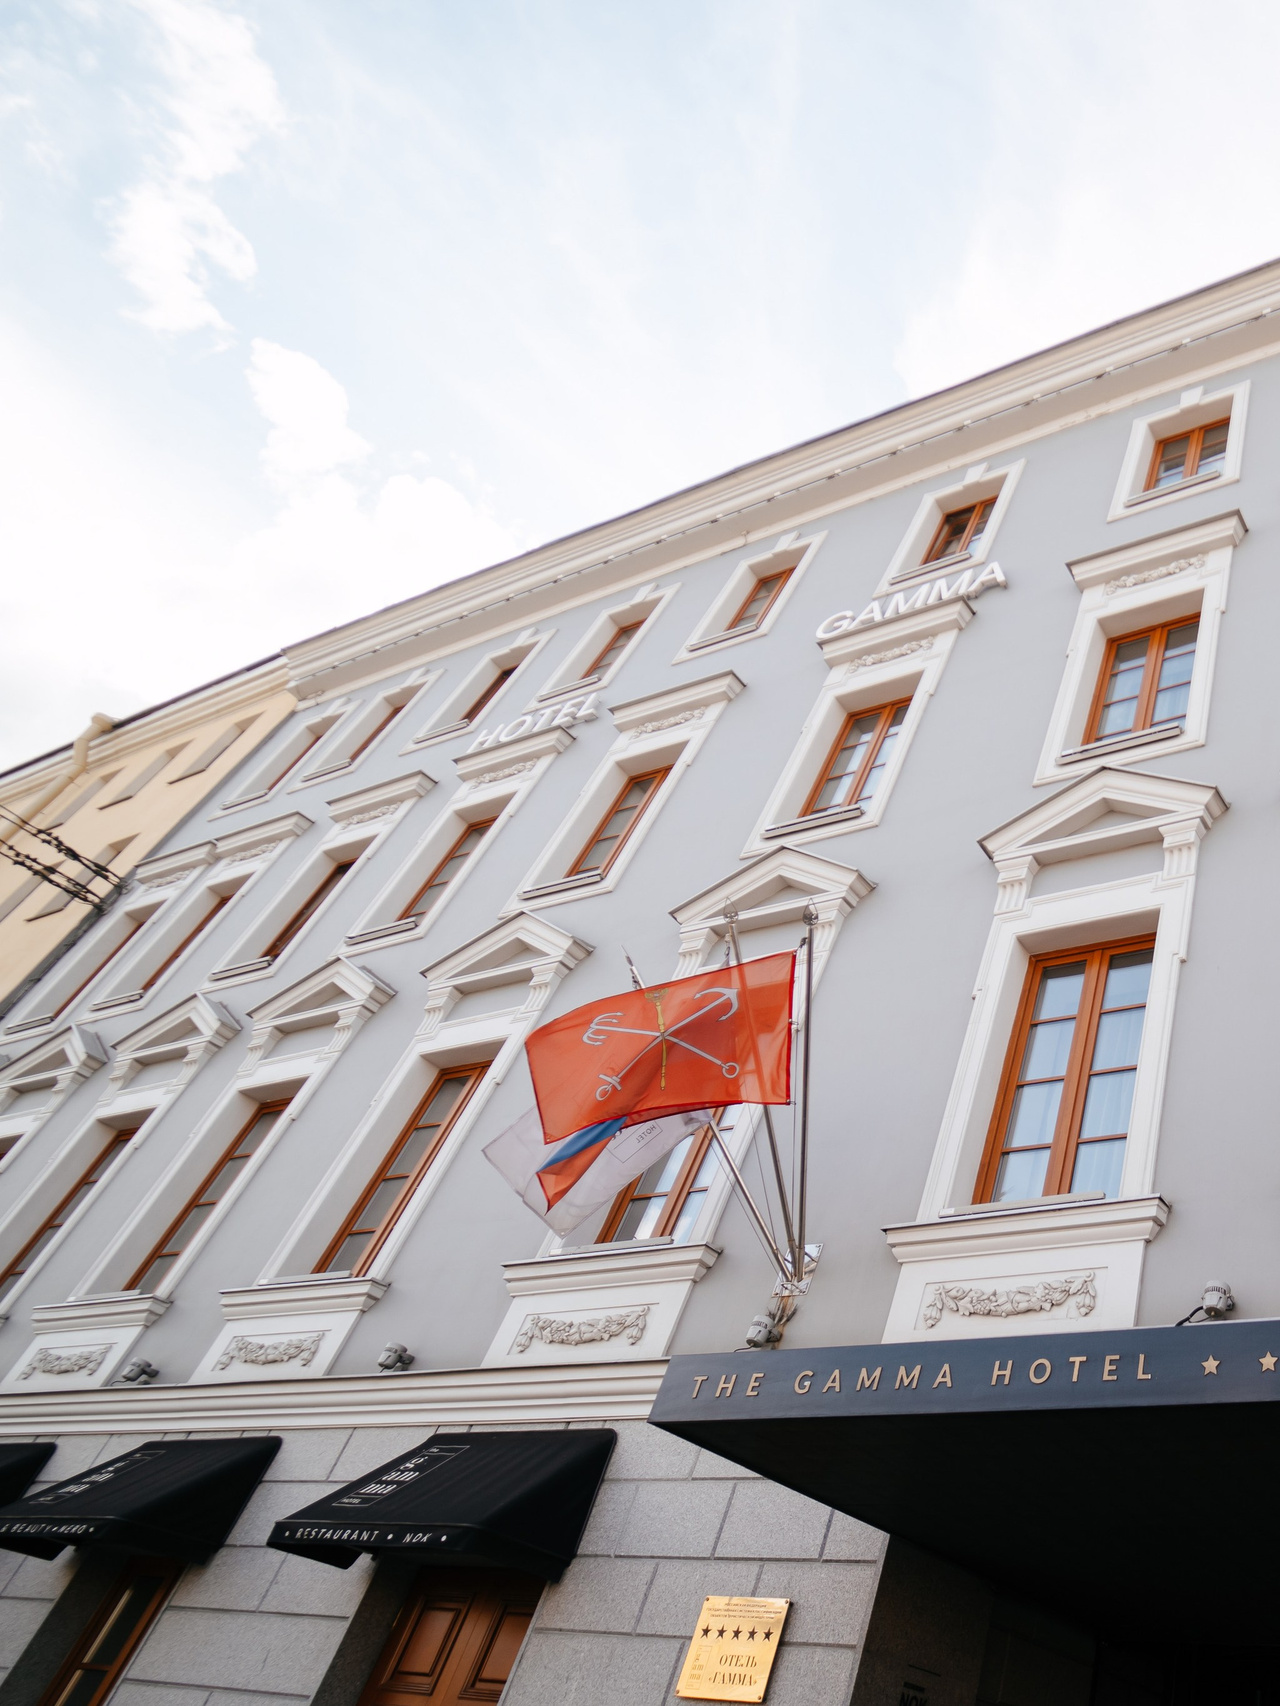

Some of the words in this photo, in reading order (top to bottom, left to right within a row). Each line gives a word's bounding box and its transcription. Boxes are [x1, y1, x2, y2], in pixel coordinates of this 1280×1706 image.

[815, 561, 1008, 639] GAMMA
[466, 692, 600, 753] HOTEL
[691, 1372, 765, 1399] THE
[793, 1363, 953, 1395] GAMMA
[990, 1353, 1152, 1386] HOTEL
[11, 1523, 53, 1533] BEAUTY
[295, 1528, 379, 1541] RESTAURANT
[719, 1654, 758, 1668] ОТЕЛЬ
